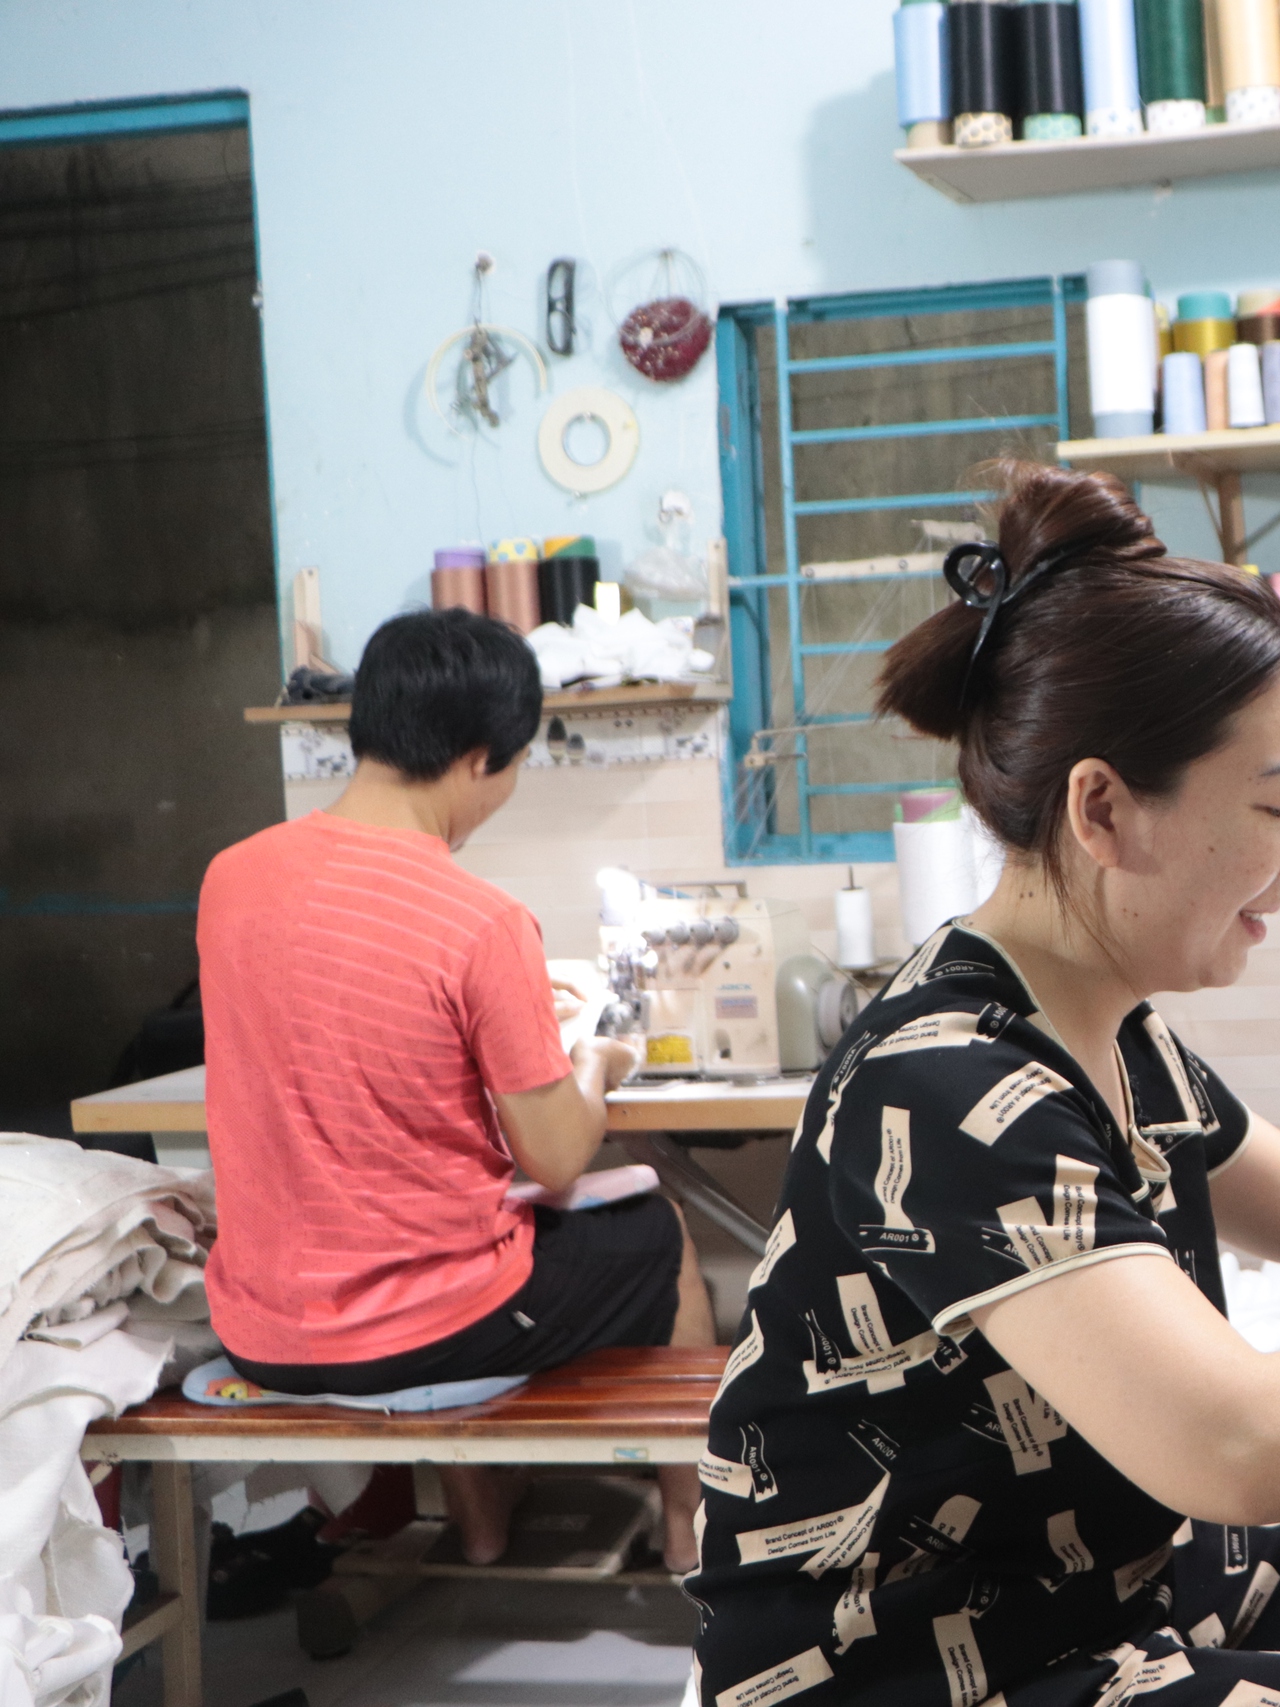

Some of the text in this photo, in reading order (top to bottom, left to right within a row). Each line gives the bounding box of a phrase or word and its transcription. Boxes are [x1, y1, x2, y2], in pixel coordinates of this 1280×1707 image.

[1064, 1201, 1073, 1226] Comes
[879, 1232, 909, 1243] AR001
[1035, 1235, 1054, 1263] Concept
[1026, 1243, 1042, 1266] Comes
[851, 1307, 872, 1350] Design Comes
[861, 1304, 870, 1324] Brand
[866, 1323, 882, 1349] Concept
[885, 1349, 906, 1361] Design
[893, 1355, 912, 1368] Brand
[1002, 1402, 1014, 1423] Design
[1011, 1422, 1022, 1442] Comes
[1012, 1398, 1024, 1416] Brand
[1020, 1415, 1033, 1438] Concept
[749, 1446, 761, 1473] AR001
[871, 1437, 897, 1461] AR001
[765, 1533, 784, 1545] Brand
[783, 1526, 808, 1540] Concept
[807, 1525, 815, 1534] of
[767, 1530, 837, 1555] Design Comes from Life
[817, 1505, 873, 1569] Design Comes from Life
[849, 1526, 867, 1552] Concept
[775, 1667, 795, 1681] Design
[947, 1646, 960, 1670] Design
[956, 1669, 966, 1692] Comes
[958, 1643, 971, 1663] Brand
[965, 1663, 978, 1689] Concept
[744, 1687, 756, 1697] from
[755, 1678, 775, 1691] Comes
[759, 1685, 783, 1700] Concept
[783, 1675, 800, 1688] Brand
